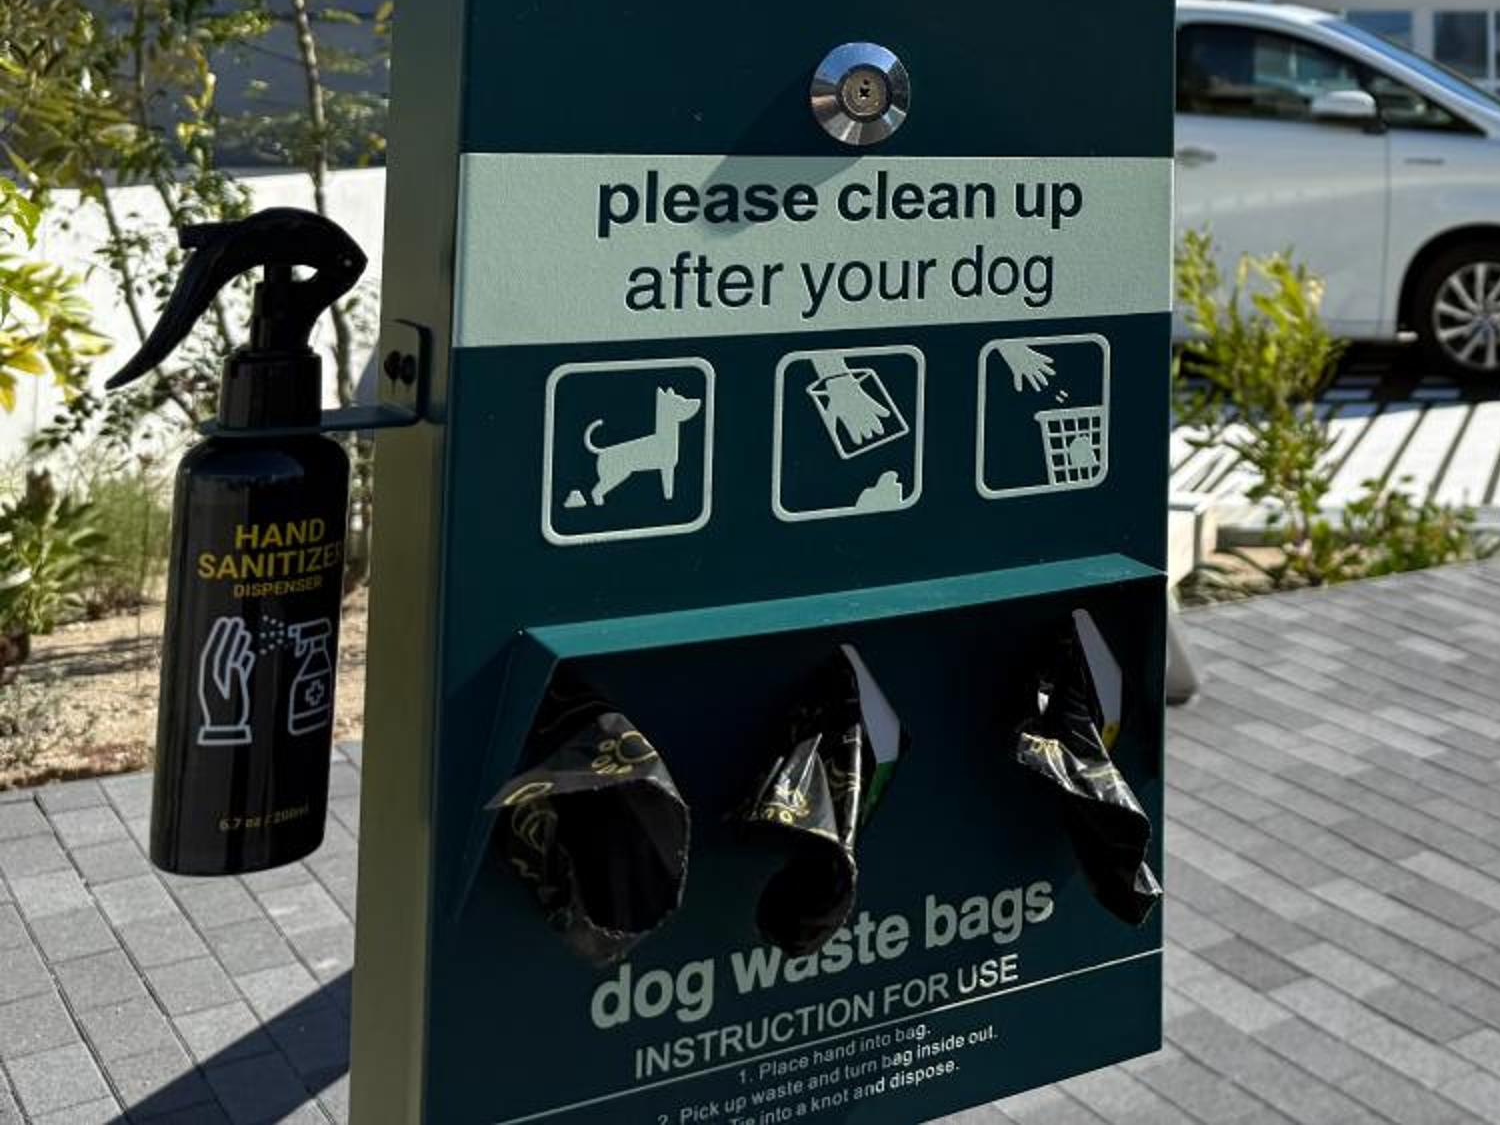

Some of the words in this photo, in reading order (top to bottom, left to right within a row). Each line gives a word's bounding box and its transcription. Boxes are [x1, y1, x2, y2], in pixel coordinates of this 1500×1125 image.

[598, 170, 818, 238] please
[837, 172, 995, 223] clean
[1015, 181, 1082, 228] up
[625, 250, 783, 310] after
[802, 256, 938, 319] your
[951, 246, 1054, 307] dog
[235, 518, 325, 549] HAND
[234, 575, 323, 598] DISPENSER
[591, 958, 715, 1028] dog
[925, 880, 1054, 949] bags
[635, 990, 875, 1079] INSTRUCTION
[884, 973, 950, 1014] FOR
[957, 954, 1019, 994] USE
[680, 1101, 720, 1125] Pick
[725, 1095, 747, 1114] up
[751, 1080, 803, 1105] waste
[808, 1070, 839, 1090] and
[844, 1059, 877, 1080] turn
[881, 1049, 913, 1069] bag
[917, 1033, 965, 1060] inside
[968, 1024, 999, 1044] out.
[740, 1069, 753, 1084] 1.
[759, 1056, 809, 1080] Place
[813, 1041, 855, 1065] hand
[861, 1034, 891, 1052] into
[895, 1024, 931, 1043] bag.
[759, 1106, 792, 1124] into
[796, 1102, 807, 1116] a
[811, 1088, 849, 1112] knot
[853, 1077, 885, 1100] and
[889, 1060, 960, 1089] dispose.
